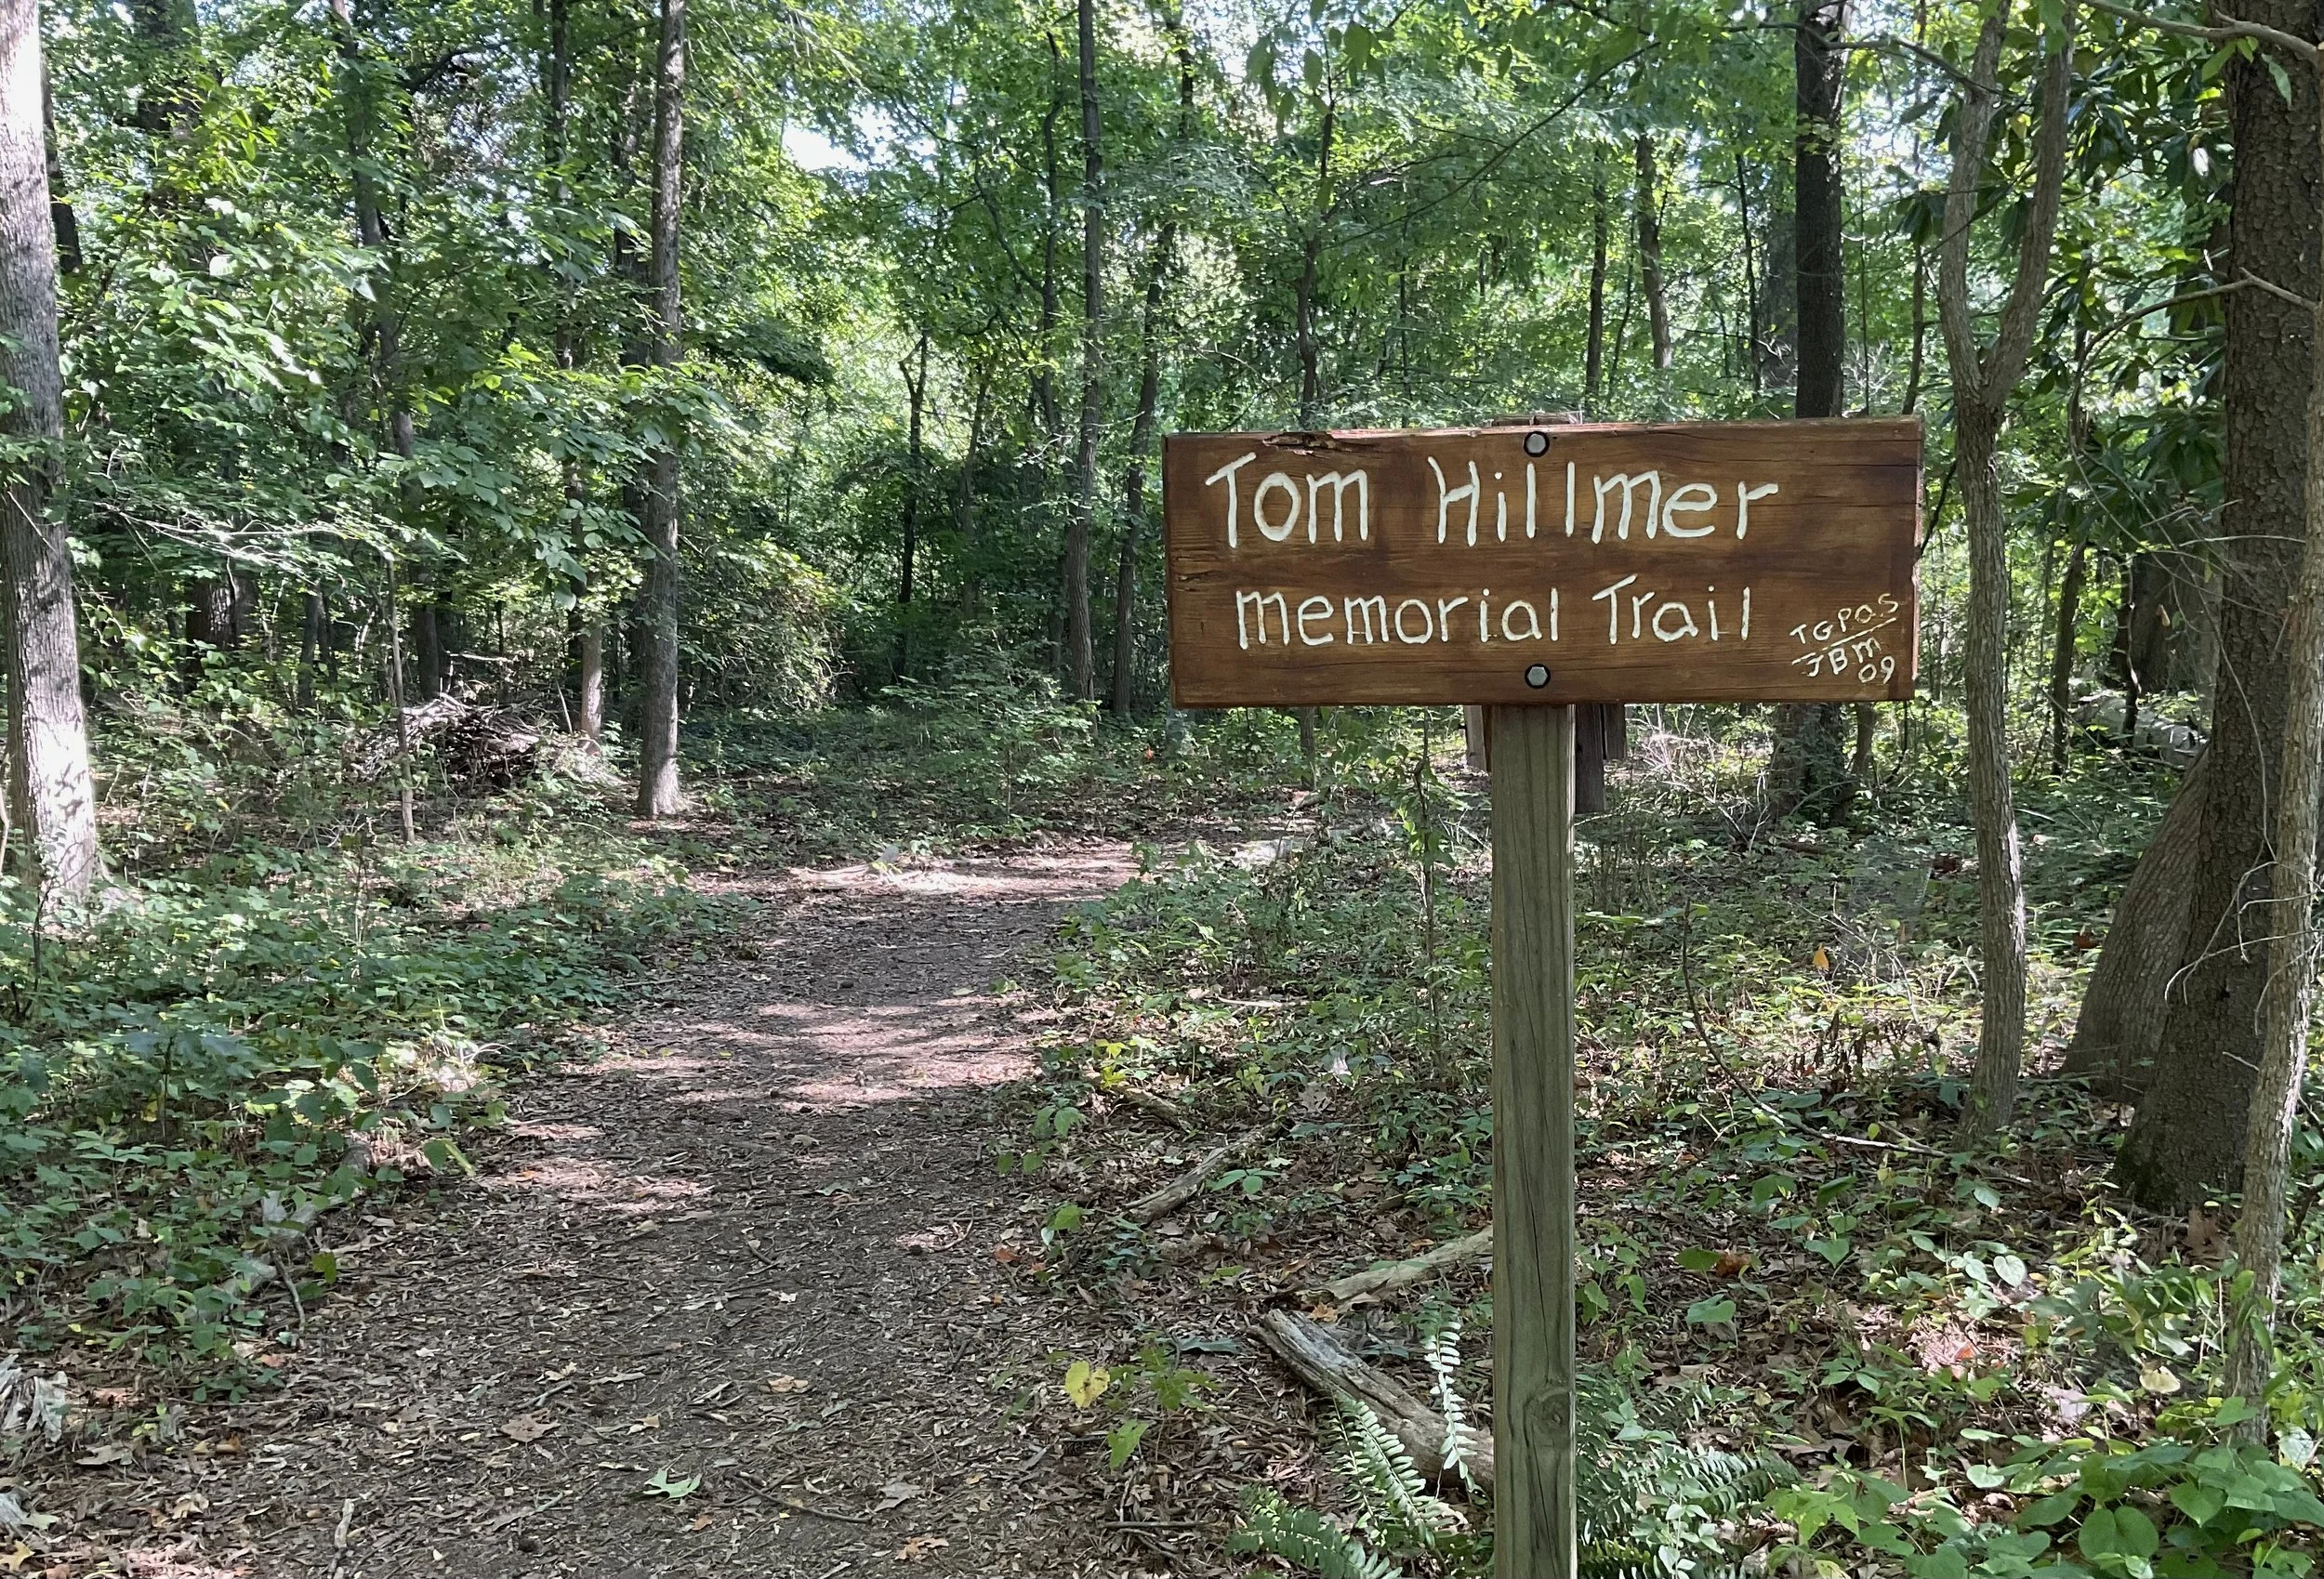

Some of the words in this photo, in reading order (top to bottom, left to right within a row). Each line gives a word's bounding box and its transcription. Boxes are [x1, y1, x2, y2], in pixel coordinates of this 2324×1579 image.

[1206, 452, 1368, 547] Tom
[1428, 455, 1778, 546] Hillmer
[1591, 573, 1750, 644] Trail
